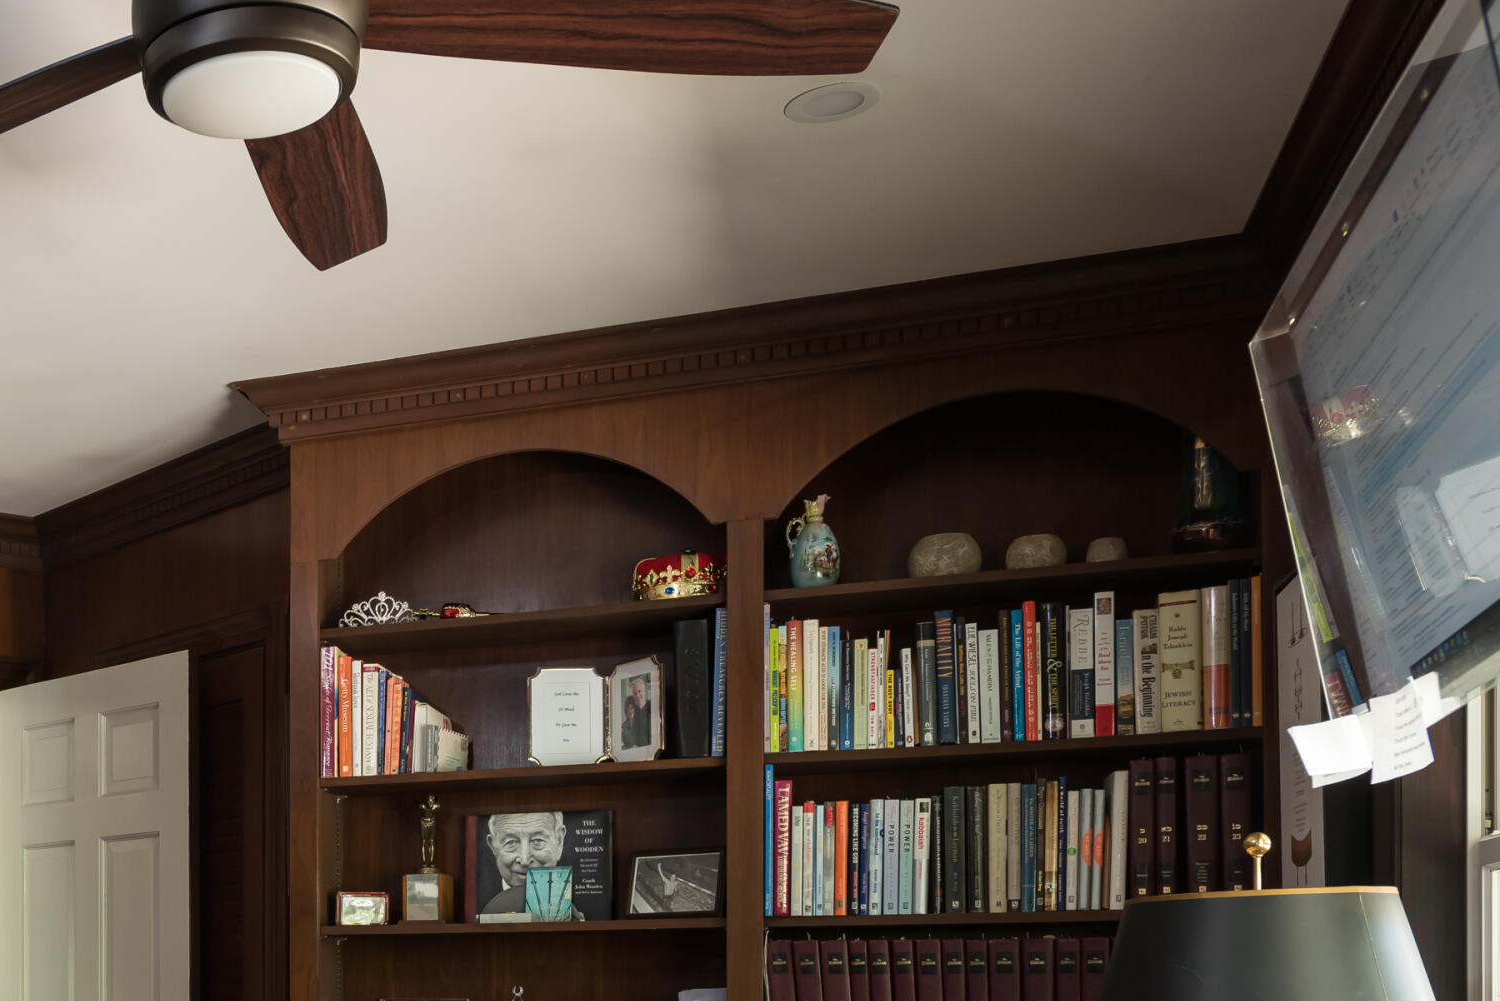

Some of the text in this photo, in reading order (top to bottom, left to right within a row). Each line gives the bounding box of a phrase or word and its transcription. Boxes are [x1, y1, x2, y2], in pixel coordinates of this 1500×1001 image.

[967, 626, 976, 640] ELIE
[1014, 623, 1022, 635] The
[1074, 614, 1090, 664] REBBE
[1139, 615, 1149, 641] POTOK
[1149, 614, 1158, 640] CHAIM
[936, 616, 954, 679] MORALITY
[968, 641, 977, 666] WIESEL
[1014, 636, 1022, 650] Life
[1050, 630, 1058, 658] LETTER
[340, 678, 349, 698] Getty
[716, 610, 728, 752] HIDDEN TREASURES REVEALED
[1139, 662, 1157, 718] the Beginning
[1161, 699, 1197, 709] LITERACY
[1164, 690, 1193, 700] JEWISH
[777, 786, 790, 832] LAMED
[851, 807, 859, 837] BECOMING
[777, 831, 790, 856] VAV
[851, 838, 859, 851] LIKE
[903, 824, 911, 853] POWER
[1137, 837, 1148, 845] 20
[1161, 835, 1171, 843] 21
[1196, 833, 1207, 841] 22
[1231, 833, 1242, 841] 23
